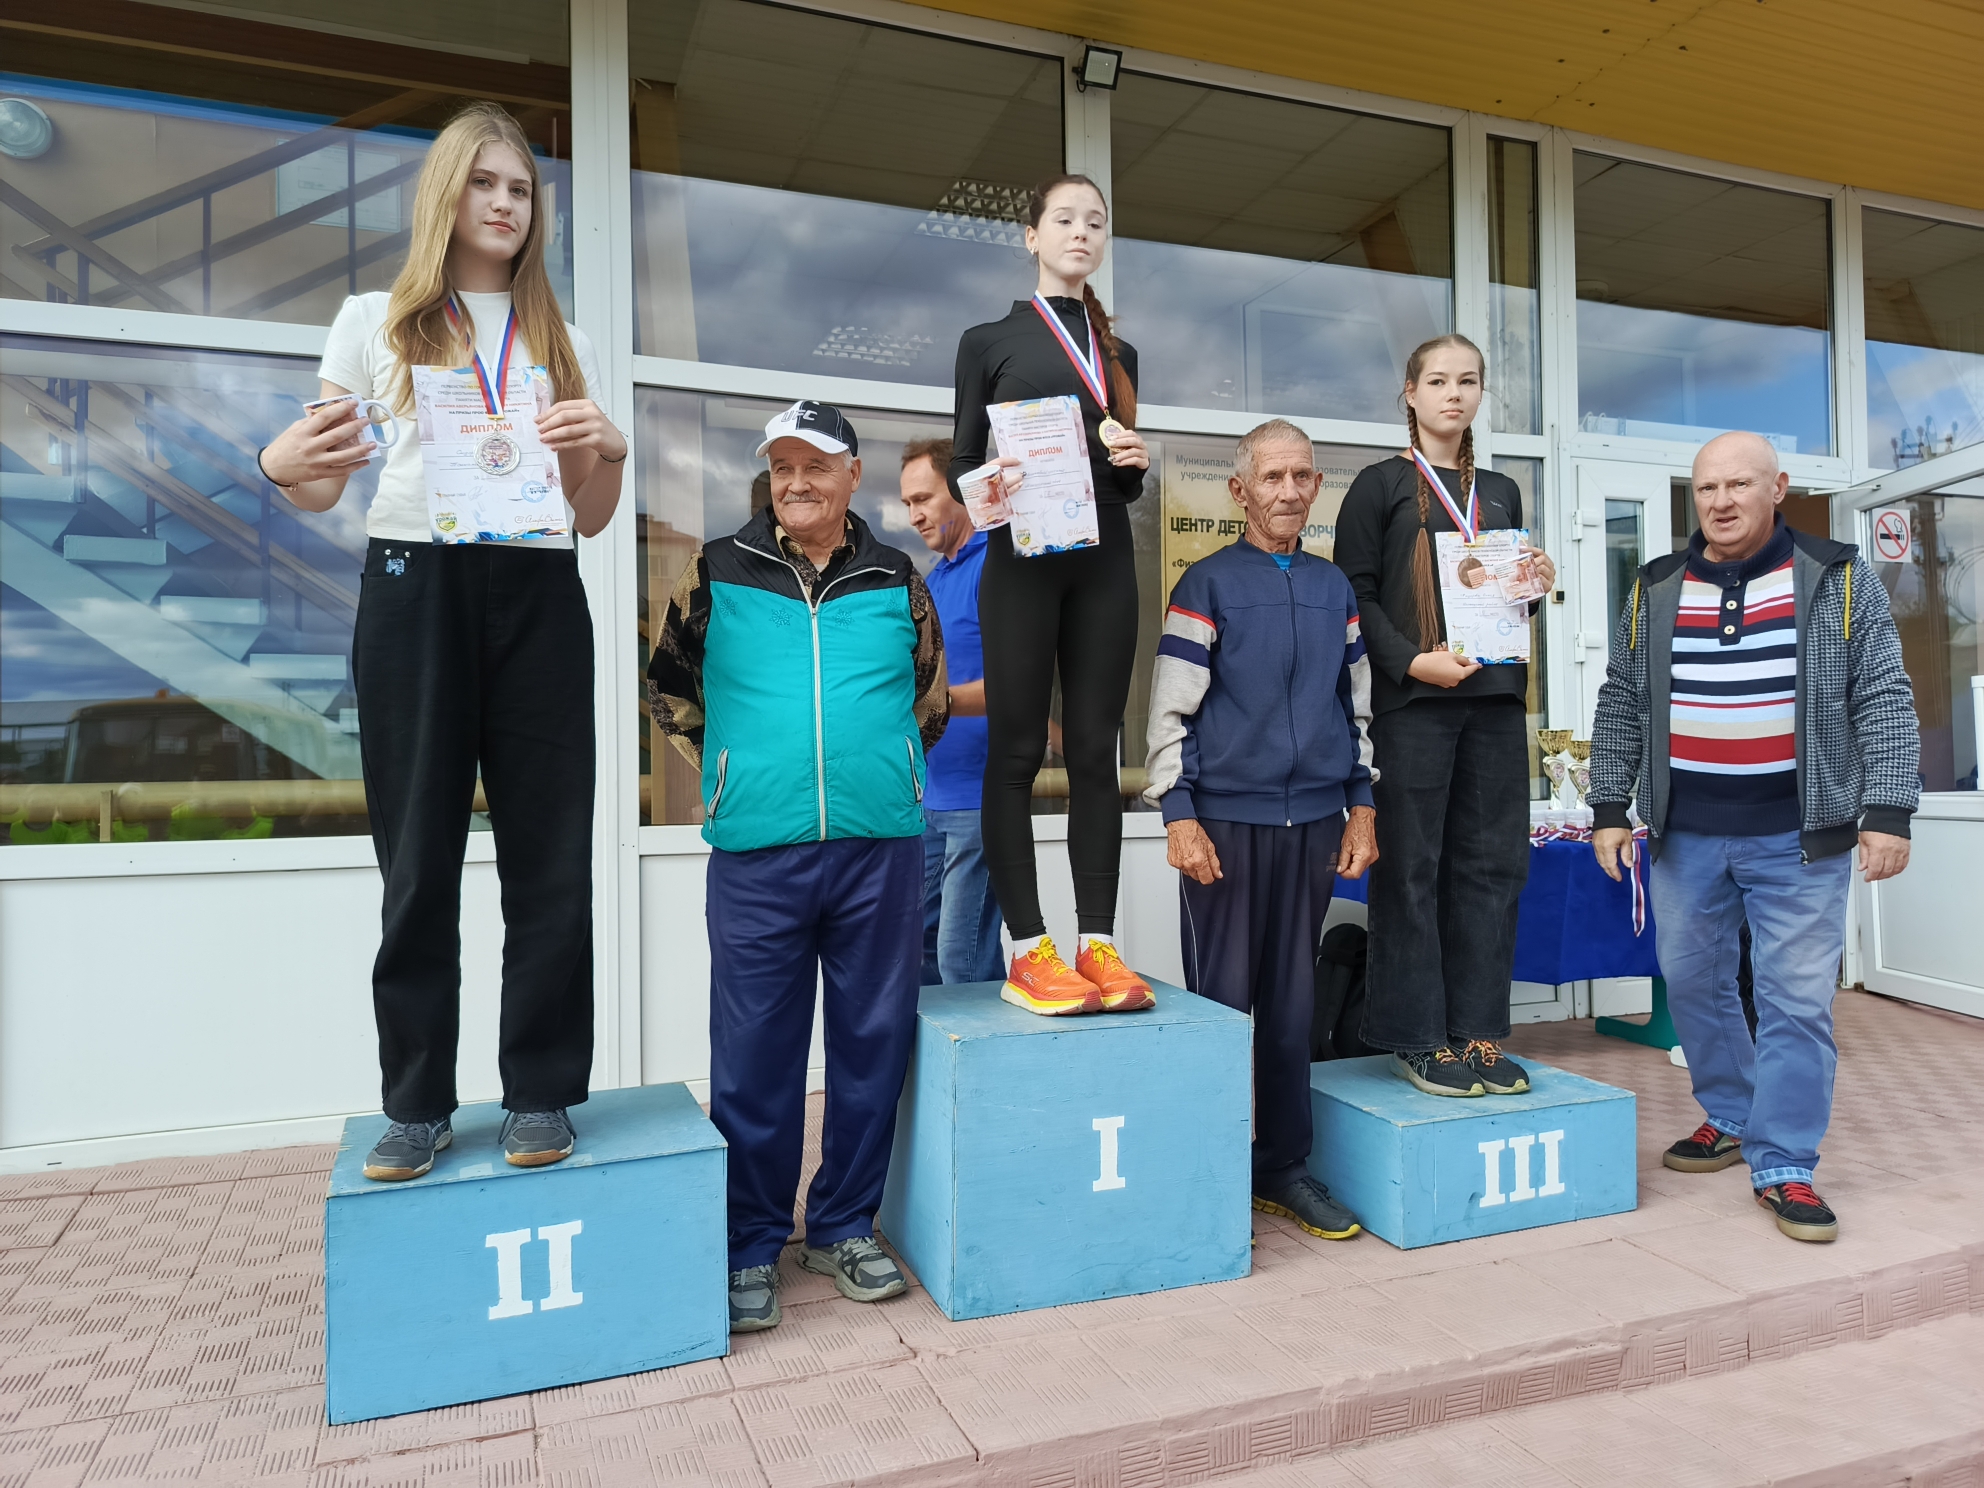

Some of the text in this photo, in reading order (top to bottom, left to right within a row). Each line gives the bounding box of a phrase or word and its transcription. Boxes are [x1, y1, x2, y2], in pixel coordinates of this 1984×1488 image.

[781, 410, 818, 422] UFC
[460, 423, 514, 434] ДИПЛОМ
[1028, 446, 1063, 458] ДИПЛОМ
[1181, 471, 1231, 482] учреждени
[1170, 517, 1215, 534] ЦЕНТР
[1300, 524, 1334, 539] ВОРЧ
[1092, 1115, 1126, 1192] I
[1478, 1129, 1565, 1208] III
[485, 1219, 584, 1320] II
